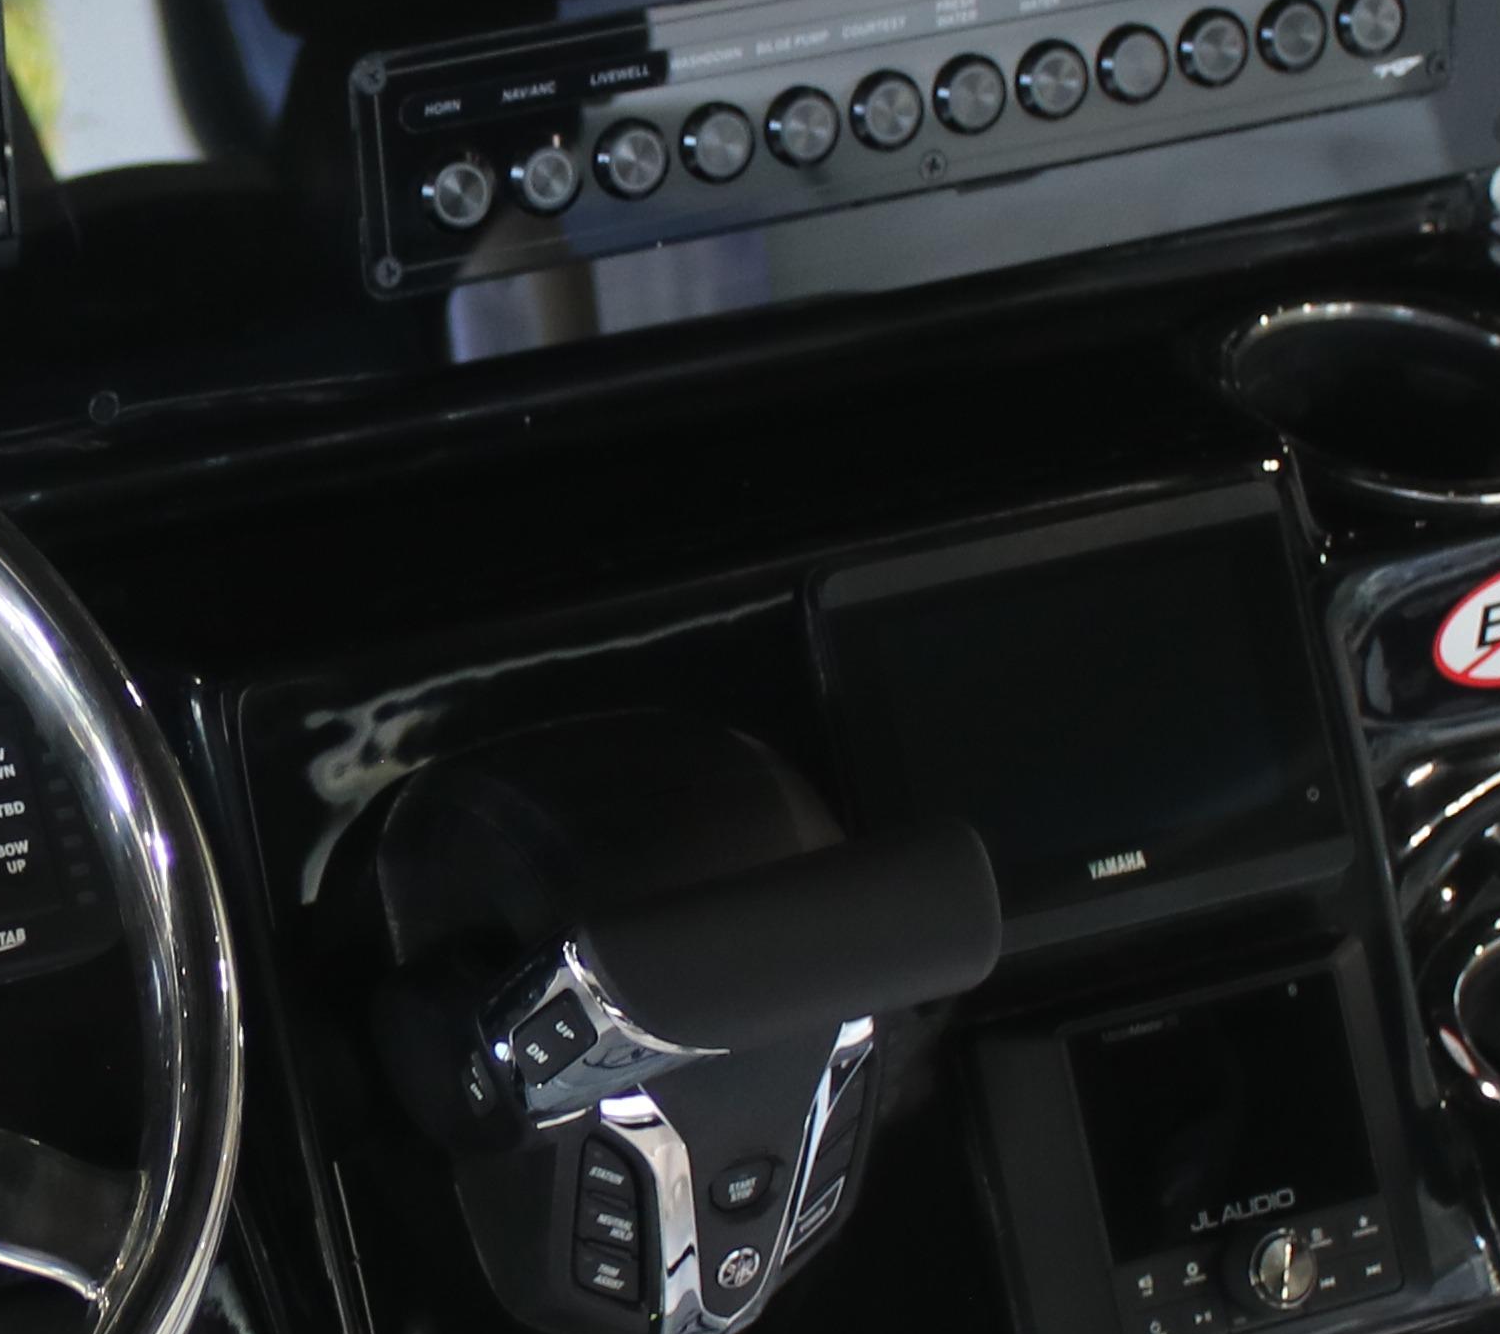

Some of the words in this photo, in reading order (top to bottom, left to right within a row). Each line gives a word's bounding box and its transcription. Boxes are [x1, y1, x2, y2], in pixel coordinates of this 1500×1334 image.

[589, 63, 650, 87] LIVEWELL
[424, 99, 461, 118] HORN
[6, 859, 27, 875] UP
[1088, 850, 1147, 880] YAMAHA
[555, 1020, 575, 1040] UP
[525, 1042, 549, 1064] DN
[1190, 1210, 1218, 1233] JL
[1221, 1187, 1296, 1224] AUDIO
